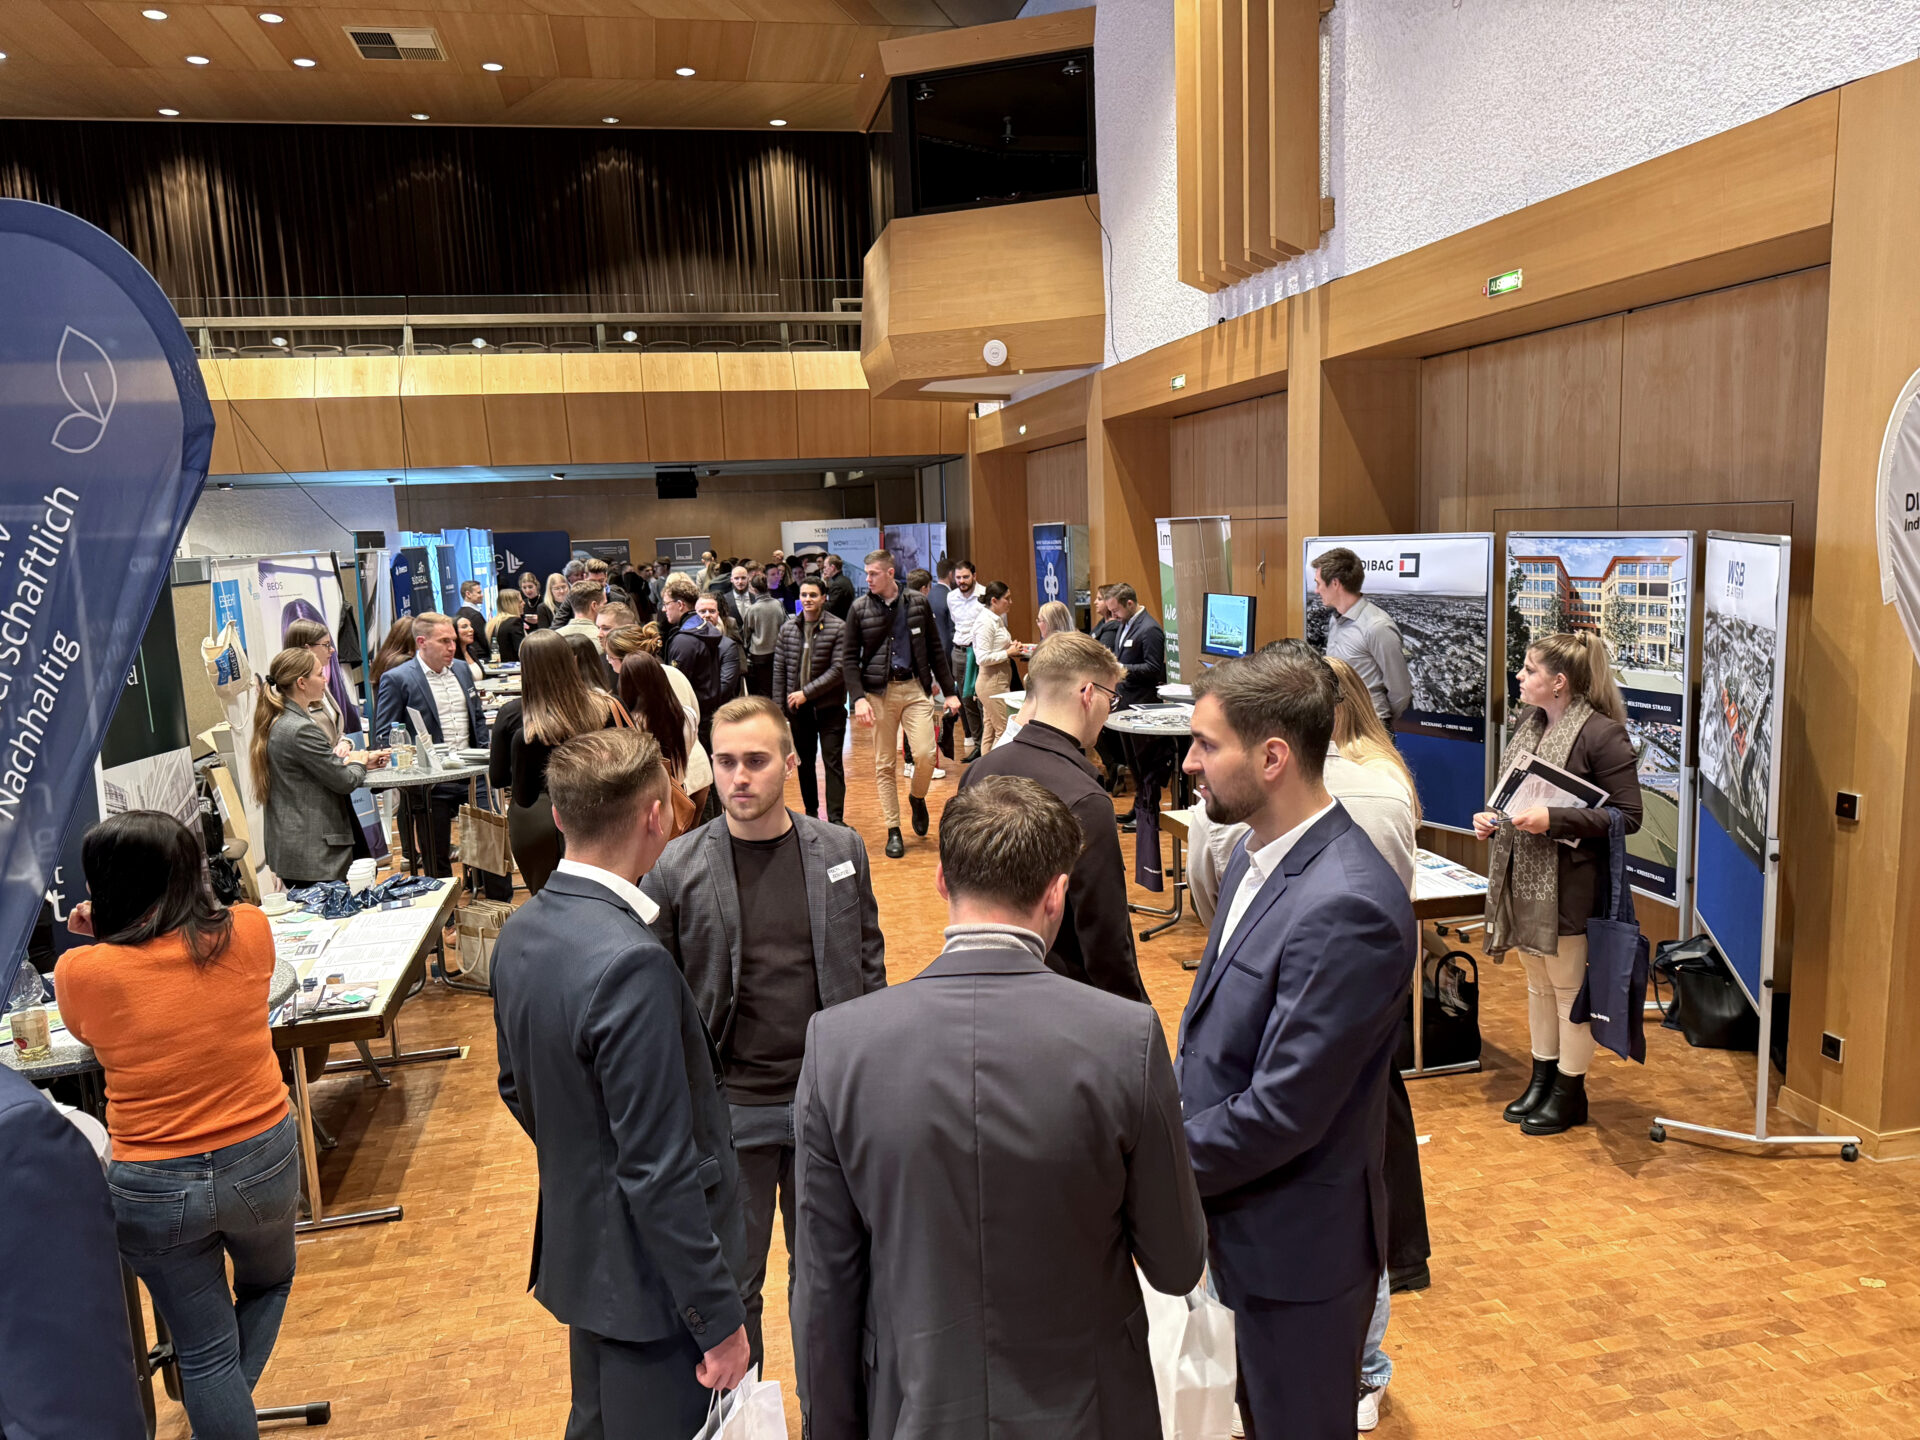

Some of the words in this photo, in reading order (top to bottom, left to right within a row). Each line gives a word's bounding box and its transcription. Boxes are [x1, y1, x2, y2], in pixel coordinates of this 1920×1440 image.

[267, 582, 283, 590] BEOS
[1727, 560, 1745, 586] WSB
[0, 630, 81, 820] Nachhaltig
